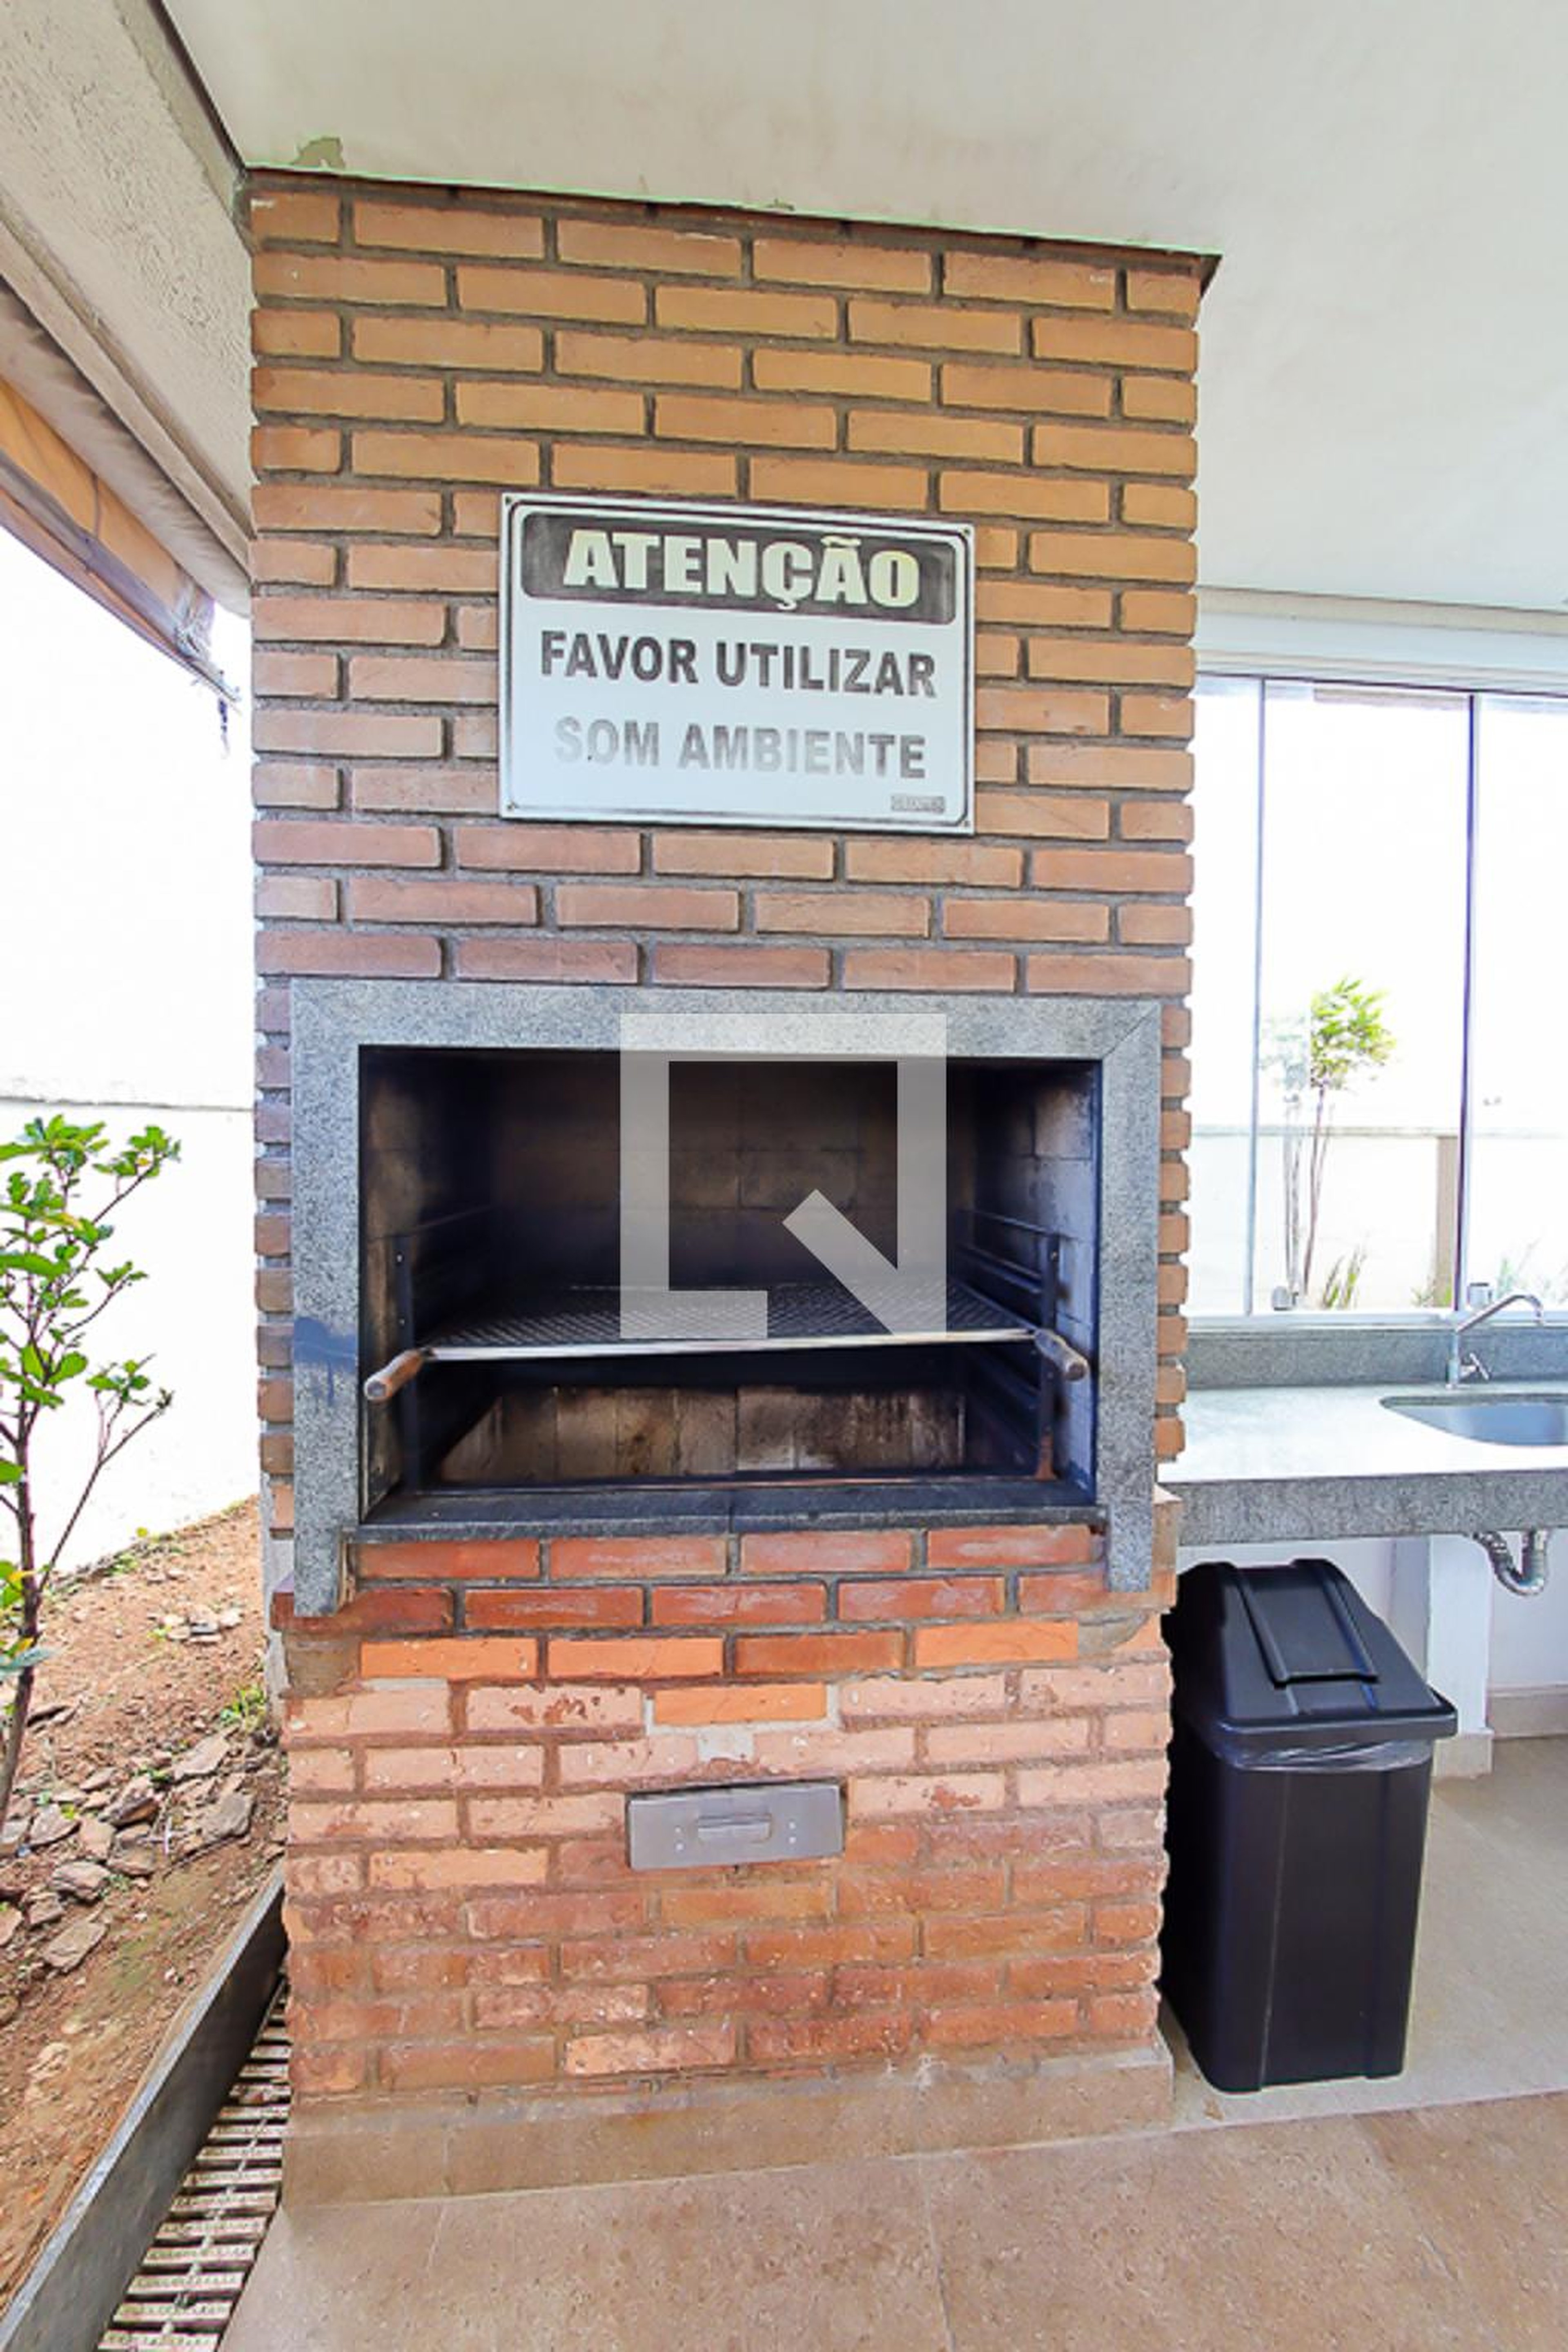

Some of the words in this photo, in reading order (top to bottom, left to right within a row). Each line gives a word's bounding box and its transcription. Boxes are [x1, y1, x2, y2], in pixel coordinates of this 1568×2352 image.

[563, 530, 920, 610] ATENÇÃO
[540, 630, 699, 684] FAVOR
[715, 641, 937, 699] UTILIZAR
[553, 716, 659, 767] SOM
[677, 723, 926, 779] AMBIENTE
